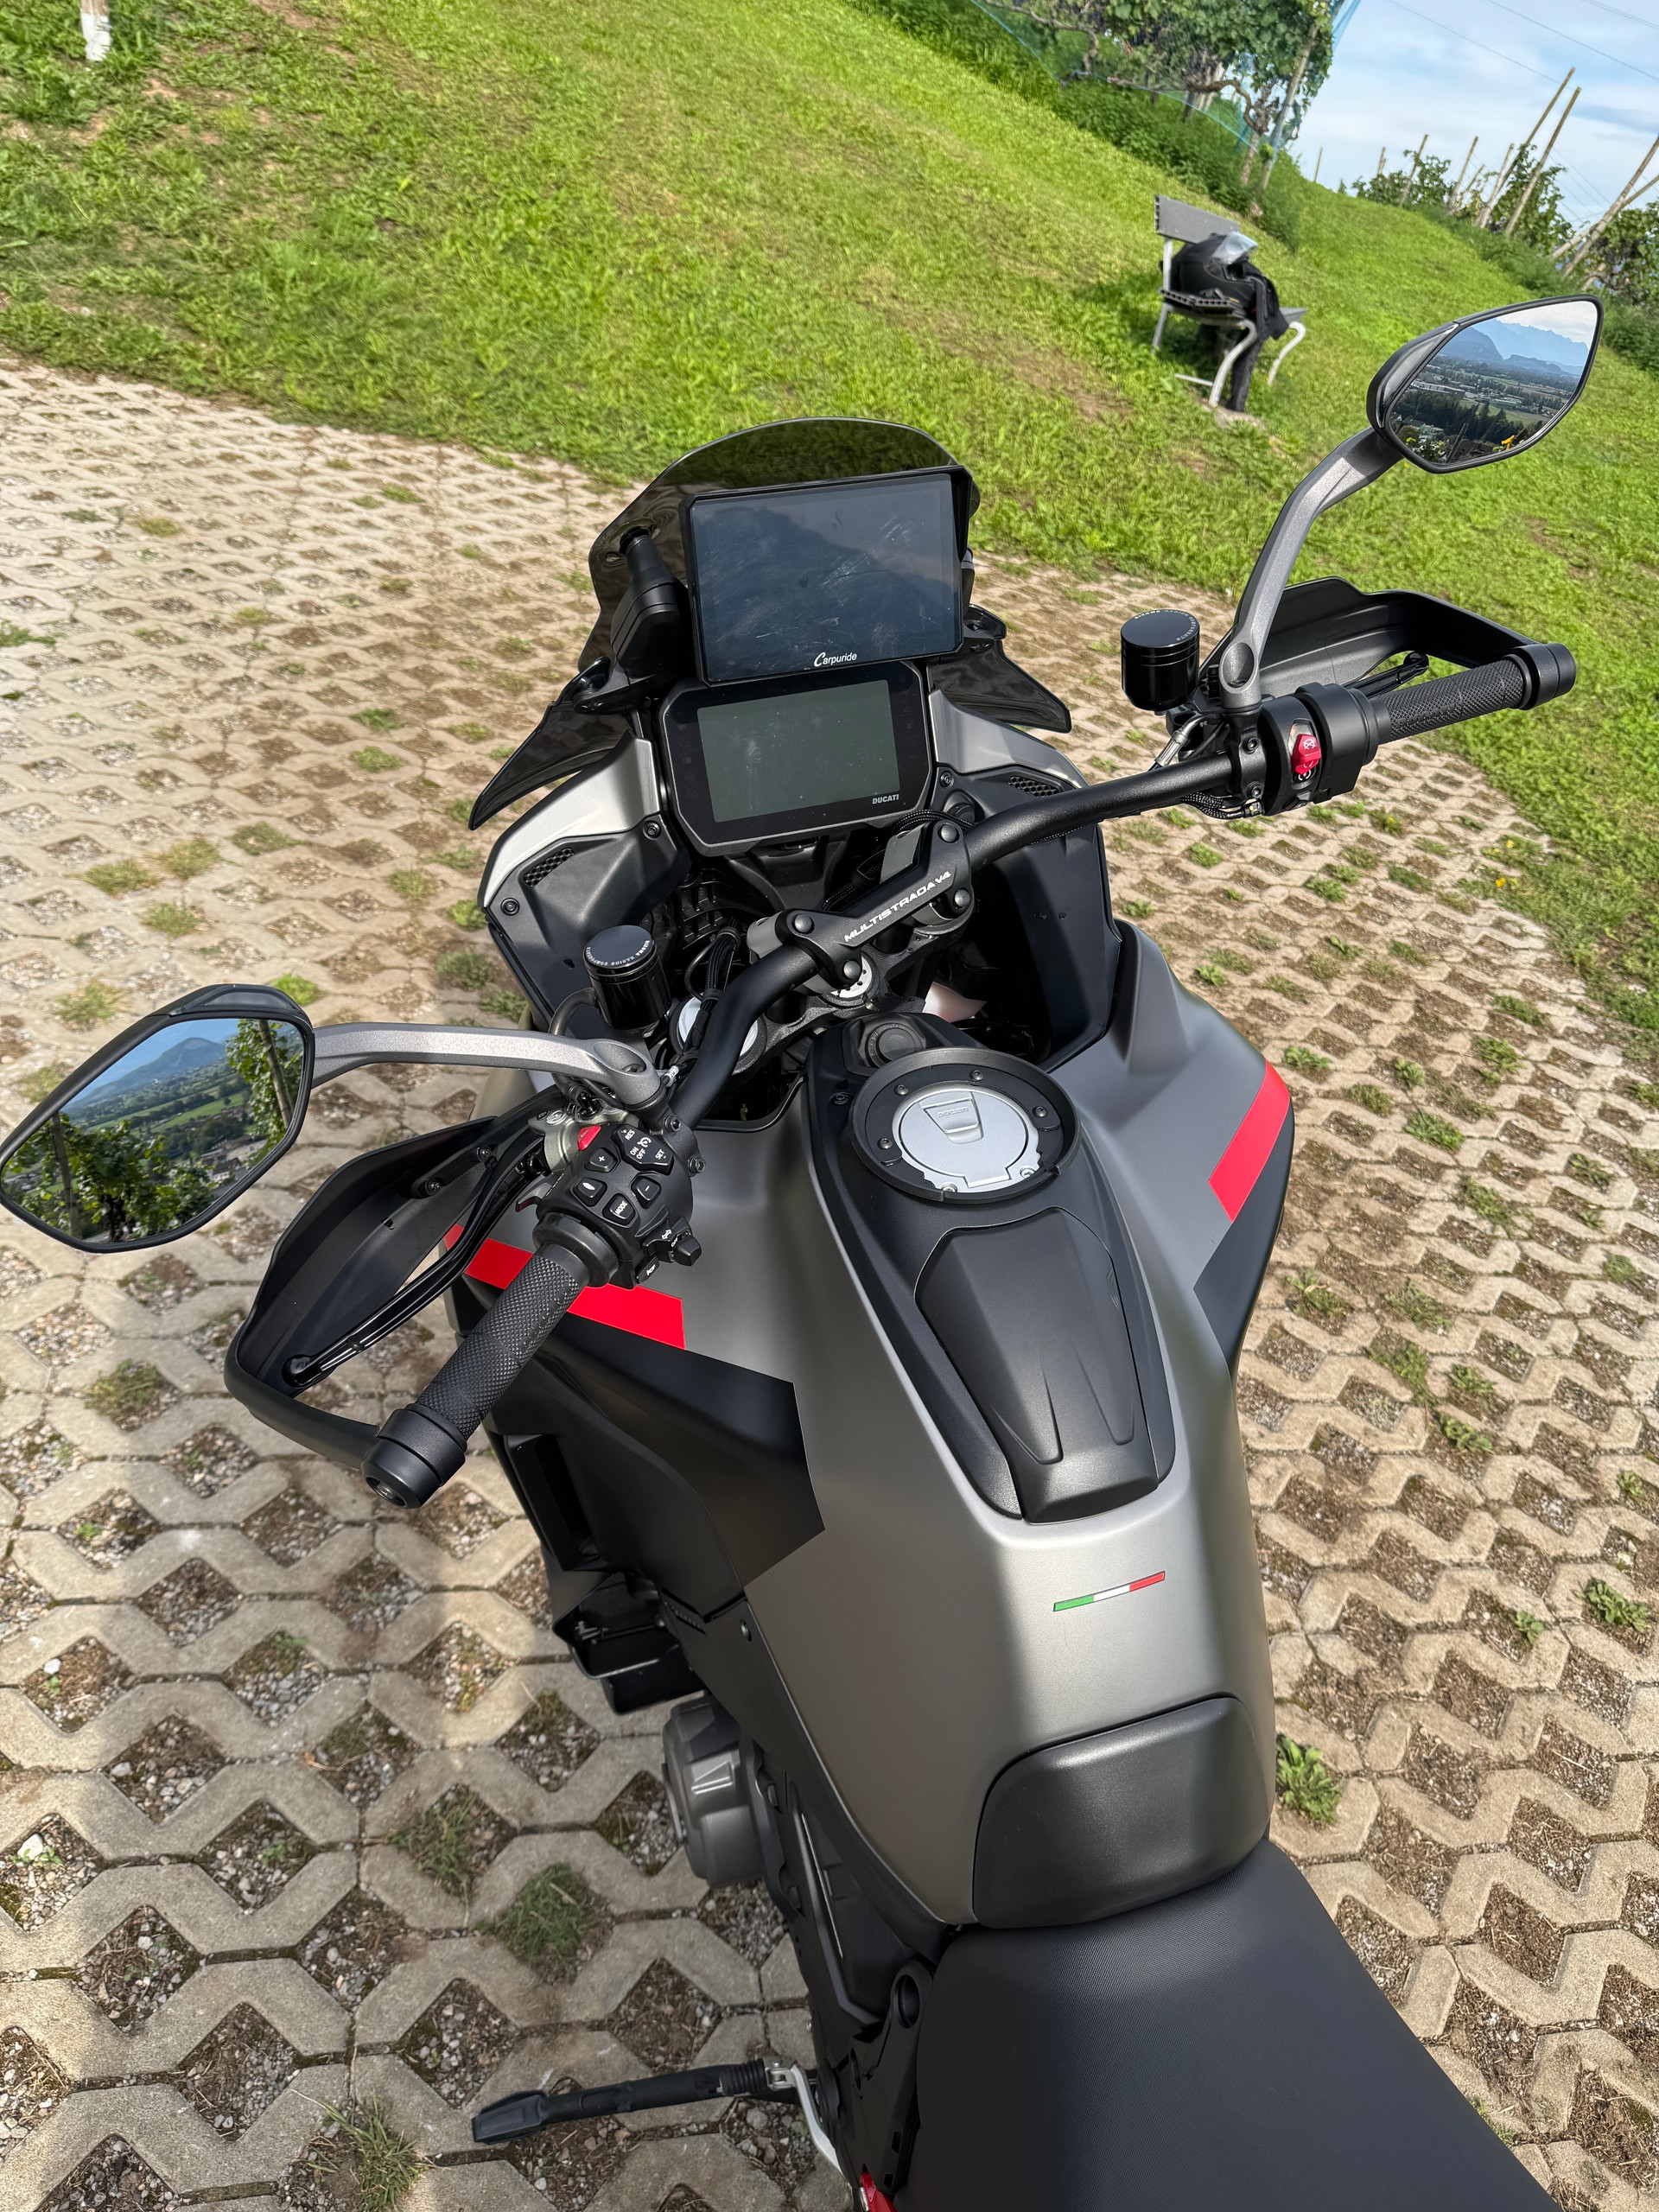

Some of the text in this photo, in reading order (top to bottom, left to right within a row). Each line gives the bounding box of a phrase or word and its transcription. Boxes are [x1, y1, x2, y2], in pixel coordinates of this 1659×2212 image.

[813, 652, 857, 667] Carpuride
[872, 794, 899, 804] DUCATI
[844, 871, 951, 942] MULTISTRADA V4
[937, 1106, 969, 1118] DUCATI
[625, 1129, 635, 1140] RES
[630, 1147, 639, 1156] ON
[636, 1148, 646, 1160] OFF
[655, 1148, 664, 1160] SET
[615, 1200, 628, 1217] MODE
